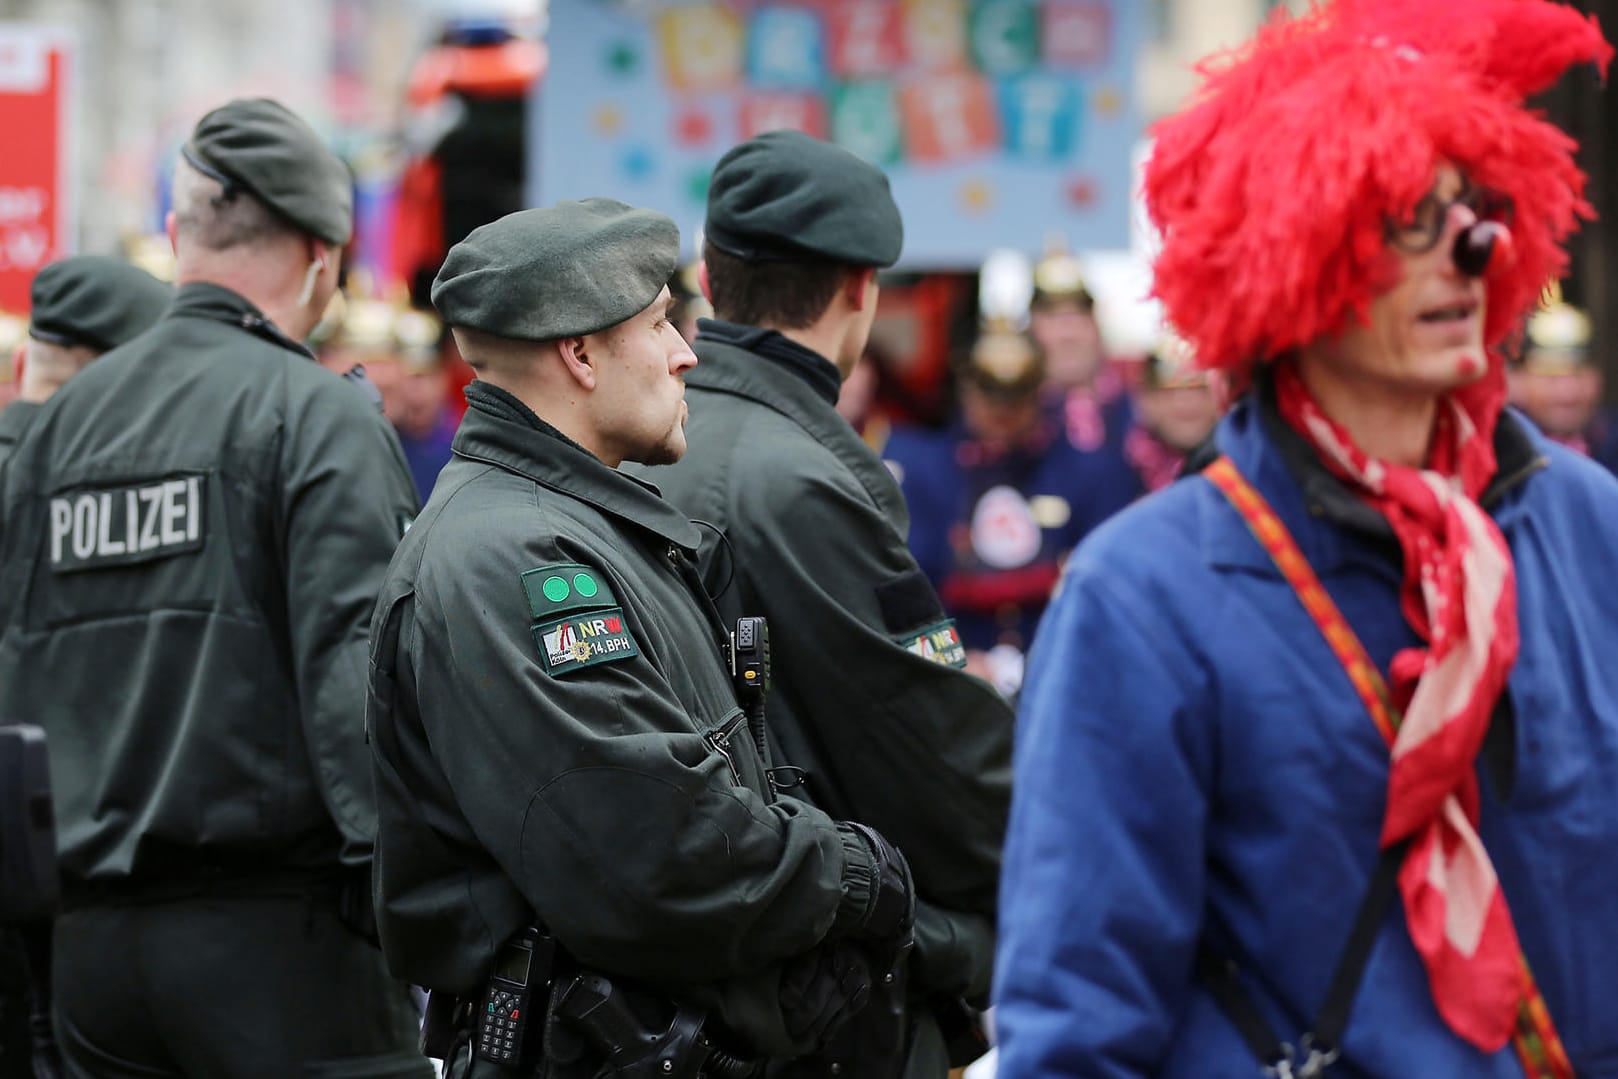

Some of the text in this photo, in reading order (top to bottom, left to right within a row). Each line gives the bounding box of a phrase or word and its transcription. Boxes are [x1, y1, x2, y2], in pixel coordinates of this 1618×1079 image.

[50, 476, 200, 563] POLIZEI
[579, 616, 622, 639] NRW
[590, 637, 631, 655] 14.BPH
